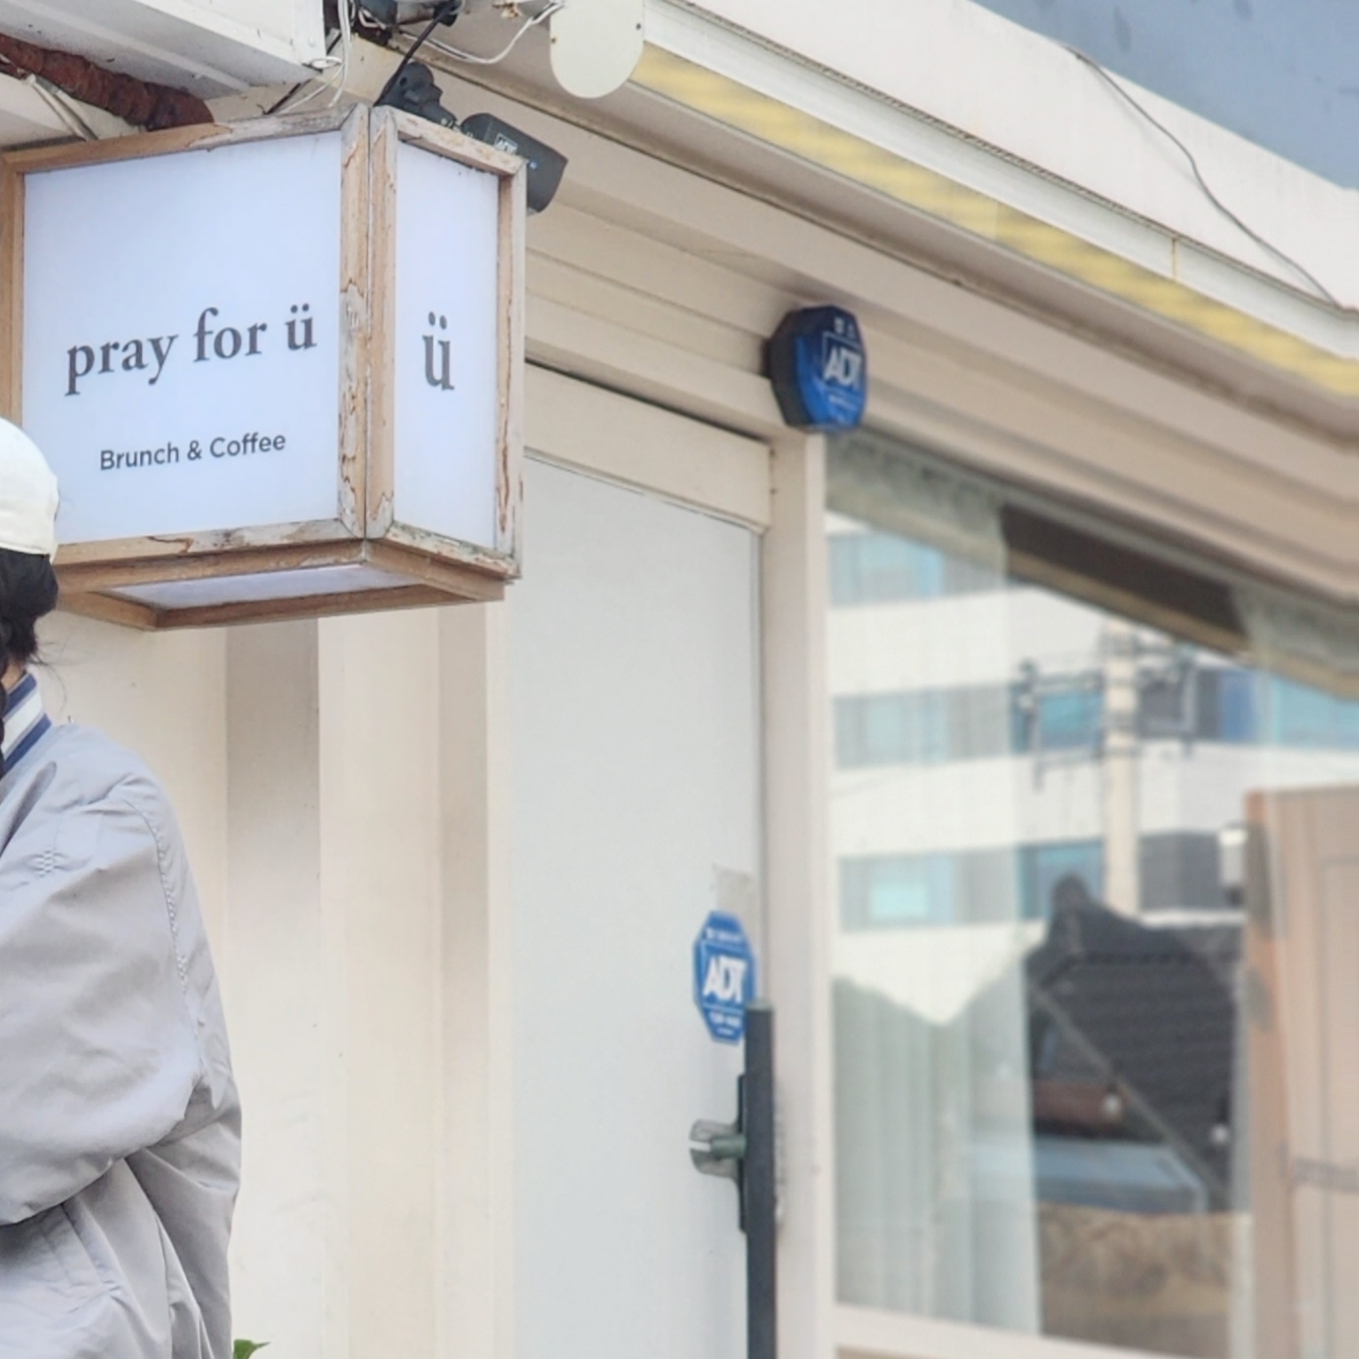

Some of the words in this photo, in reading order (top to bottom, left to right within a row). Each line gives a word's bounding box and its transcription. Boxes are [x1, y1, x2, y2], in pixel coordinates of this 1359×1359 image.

[64, 337, 179, 397] pray
[193, 307, 268, 363] for
[284, 303, 318, 351] ü
[421, 310, 455, 391] ü
[100, 441, 180, 471] Brunch
[187, 439, 203, 461] &
[209, 431, 287, 458] Coffee
[702, 954, 748, 1004] ADT
